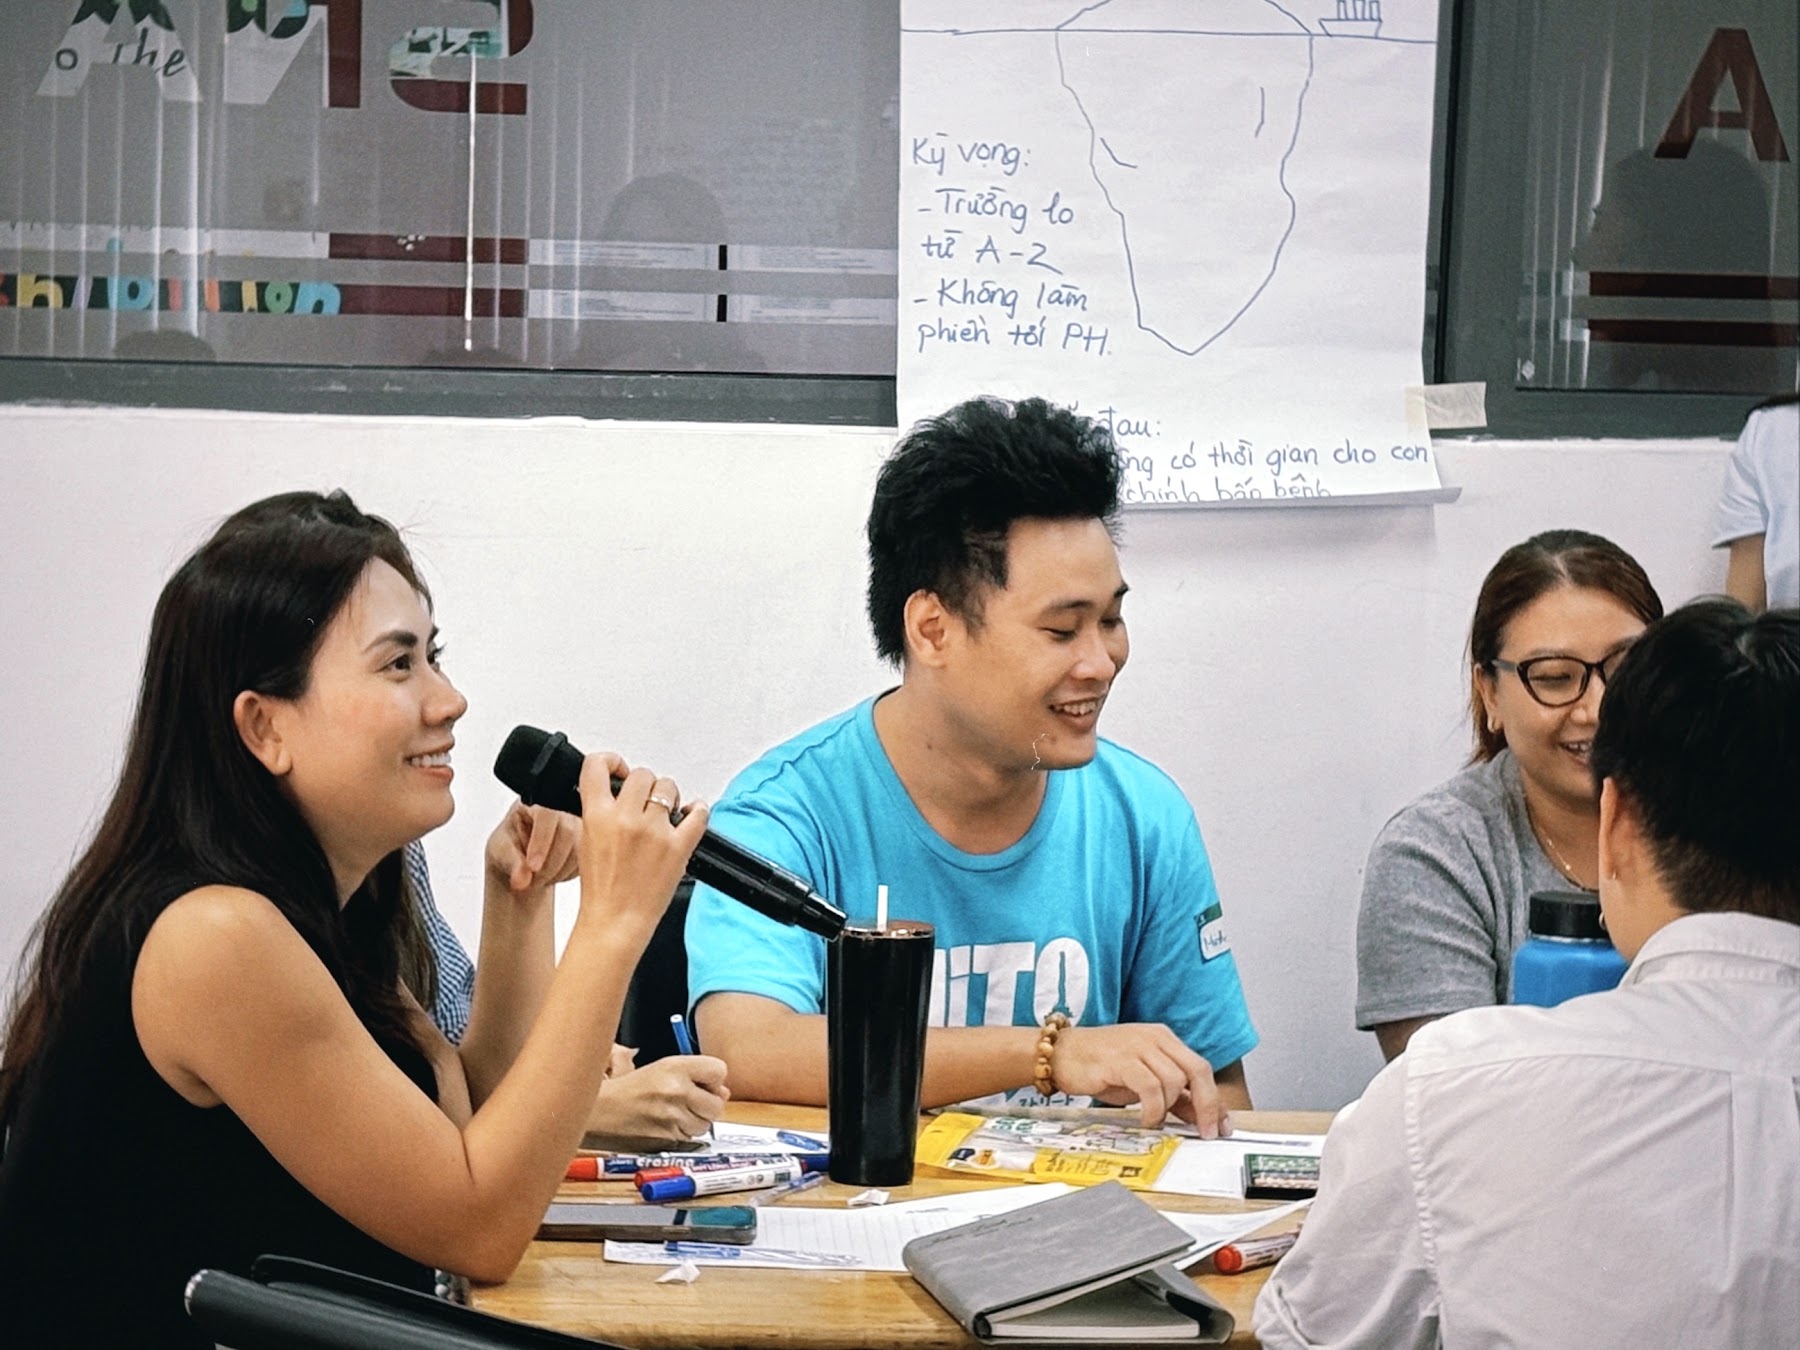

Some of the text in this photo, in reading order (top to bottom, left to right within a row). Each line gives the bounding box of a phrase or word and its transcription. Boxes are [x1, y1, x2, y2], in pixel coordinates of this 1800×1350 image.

[1654, 28, 1790, 162] A
[957, 142, 1031, 176] vọng:
[1042, 192, 1075, 225] lo
[938, 278, 1019, 320] Không
[918, 315, 991, 353] phiền
[1007, 315, 1047, 348] tới
[1170, 440, 1197, 470] có
[1207, 439, 1254, 469] thời
[1265, 443, 1319, 476] gian
[1332, 438, 1378, 464] cho
[1390, 443, 1429, 464] con
